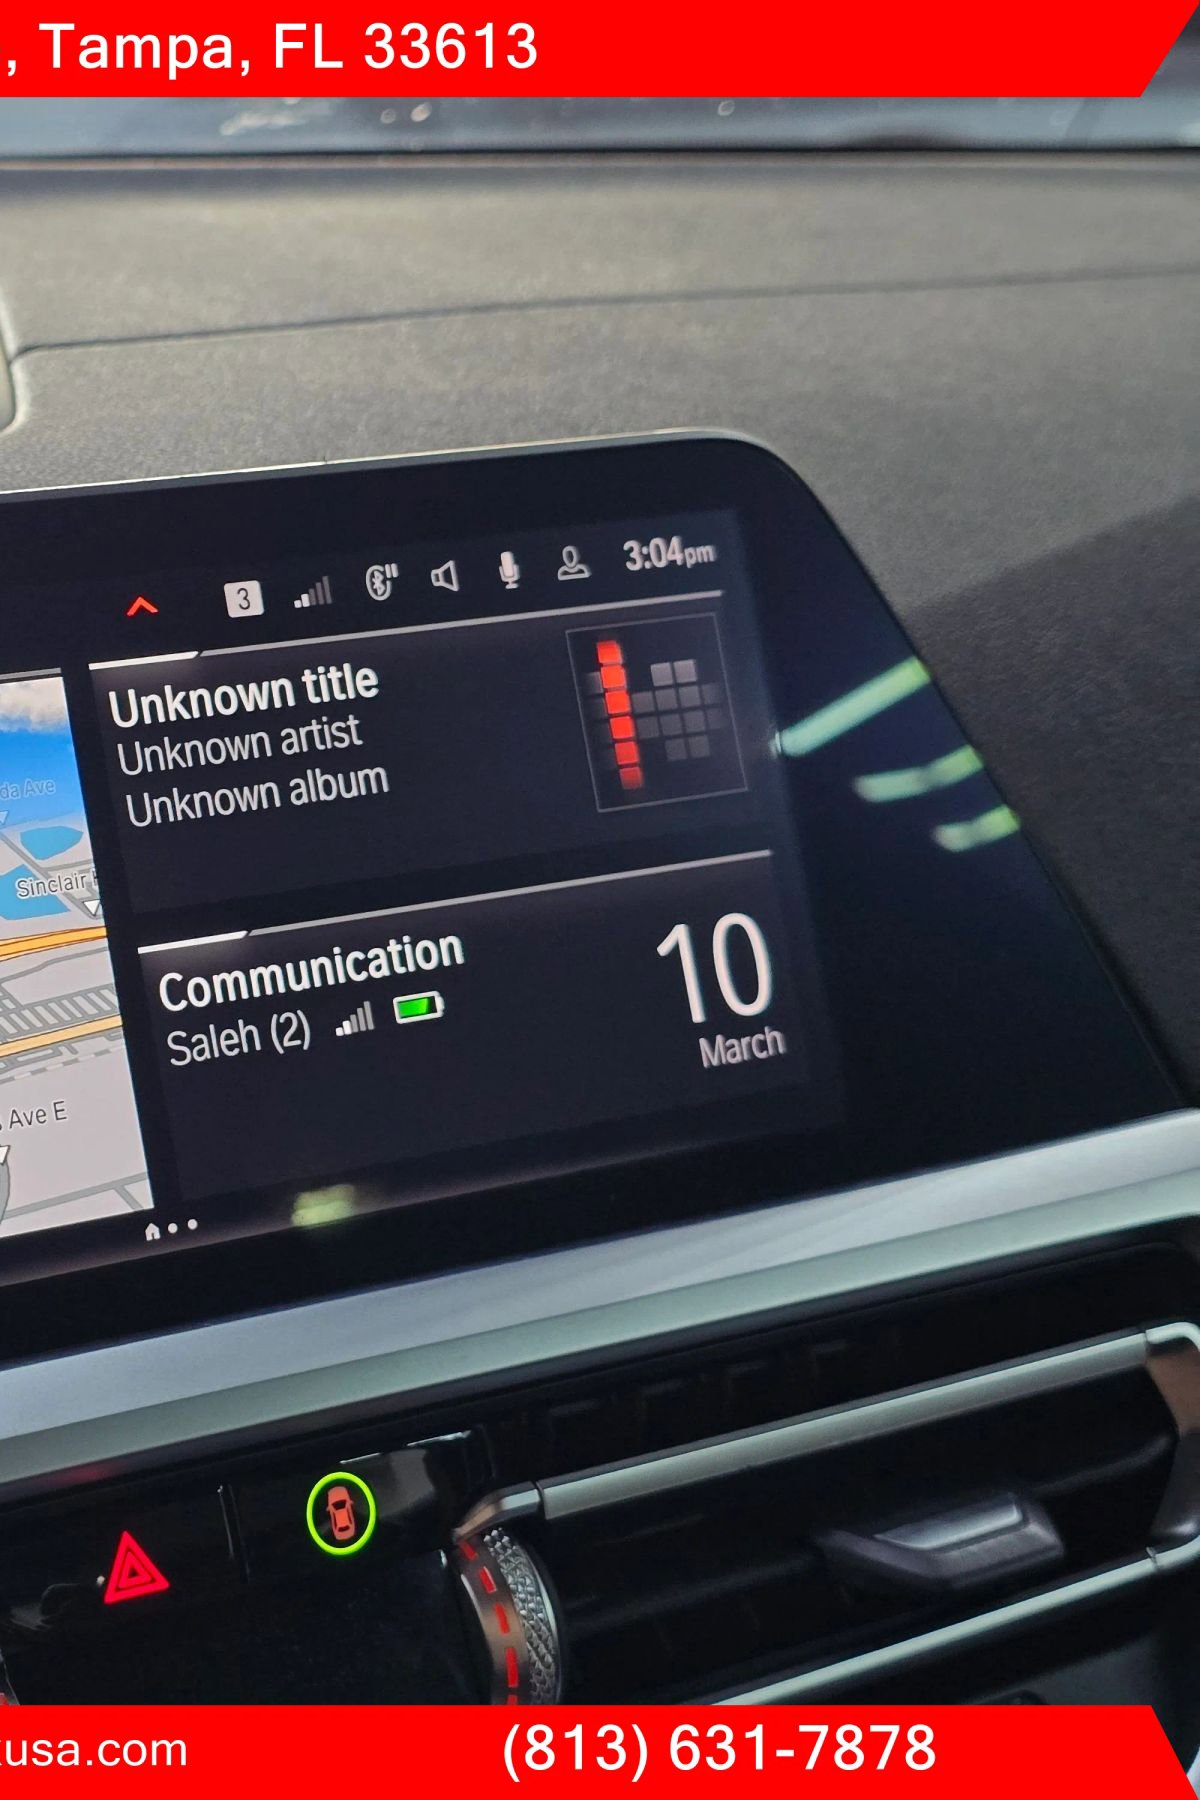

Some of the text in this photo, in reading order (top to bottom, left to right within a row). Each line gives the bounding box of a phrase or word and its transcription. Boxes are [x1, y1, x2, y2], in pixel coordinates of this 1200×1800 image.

[236, 587, 252, 612] 3
[108, 662, 379, 728] Unknown title
[117, 714, 363, 776] Unknown artist
[23, 778, 56, 797] Ave
[125, 766, 390, 827] Unknown album
[16, 872, 88, 898] Sinclair
[159, 935, 465, 1012] Communication
[656, 912, 773, 1023] 10
[166, 1009, 311, 1066] Saleh (2)
[698, 1026, 787, 1069] March
[6, 1109, 46, 1130] Ave
[52, 1101, 67, 1122] E
